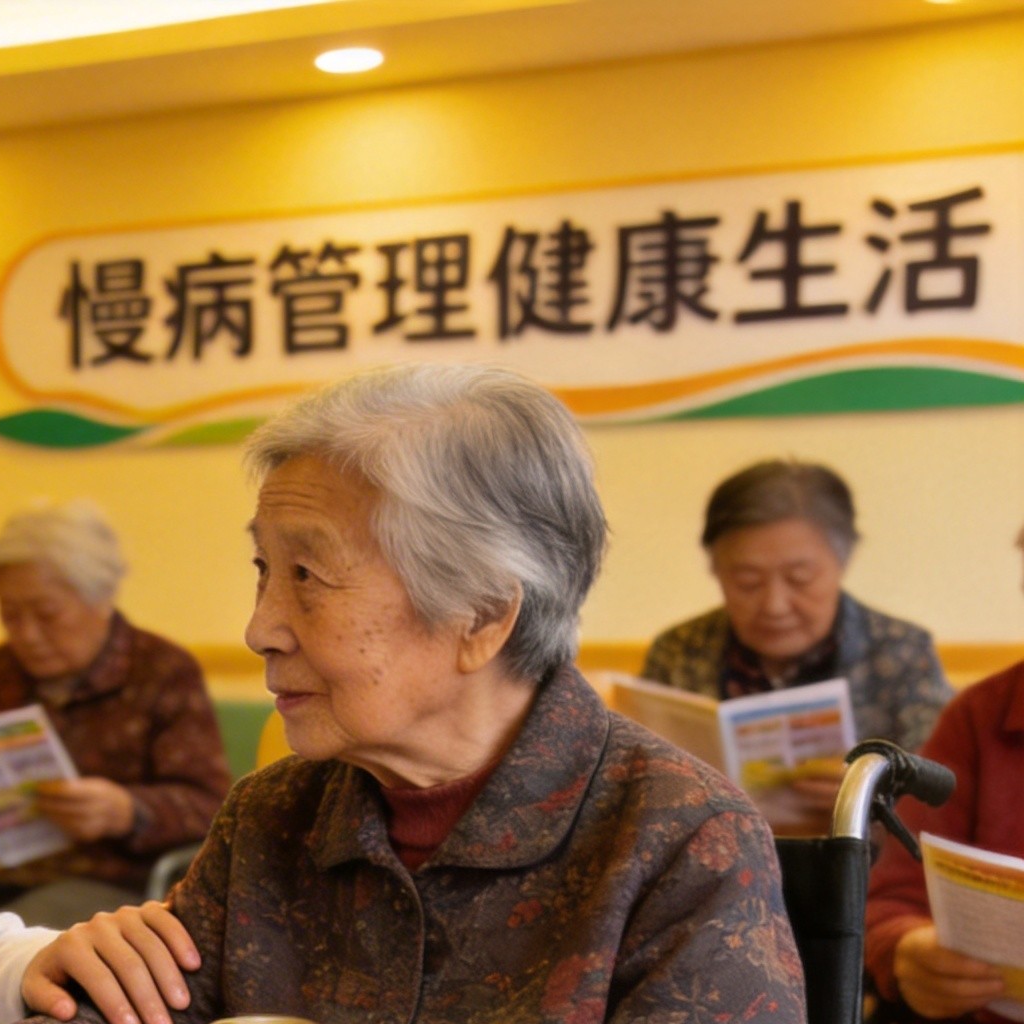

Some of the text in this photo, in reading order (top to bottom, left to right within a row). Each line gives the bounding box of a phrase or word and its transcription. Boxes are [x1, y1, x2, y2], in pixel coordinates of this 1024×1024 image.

[60, 188, 989, 367] 慢病管理健康生活
